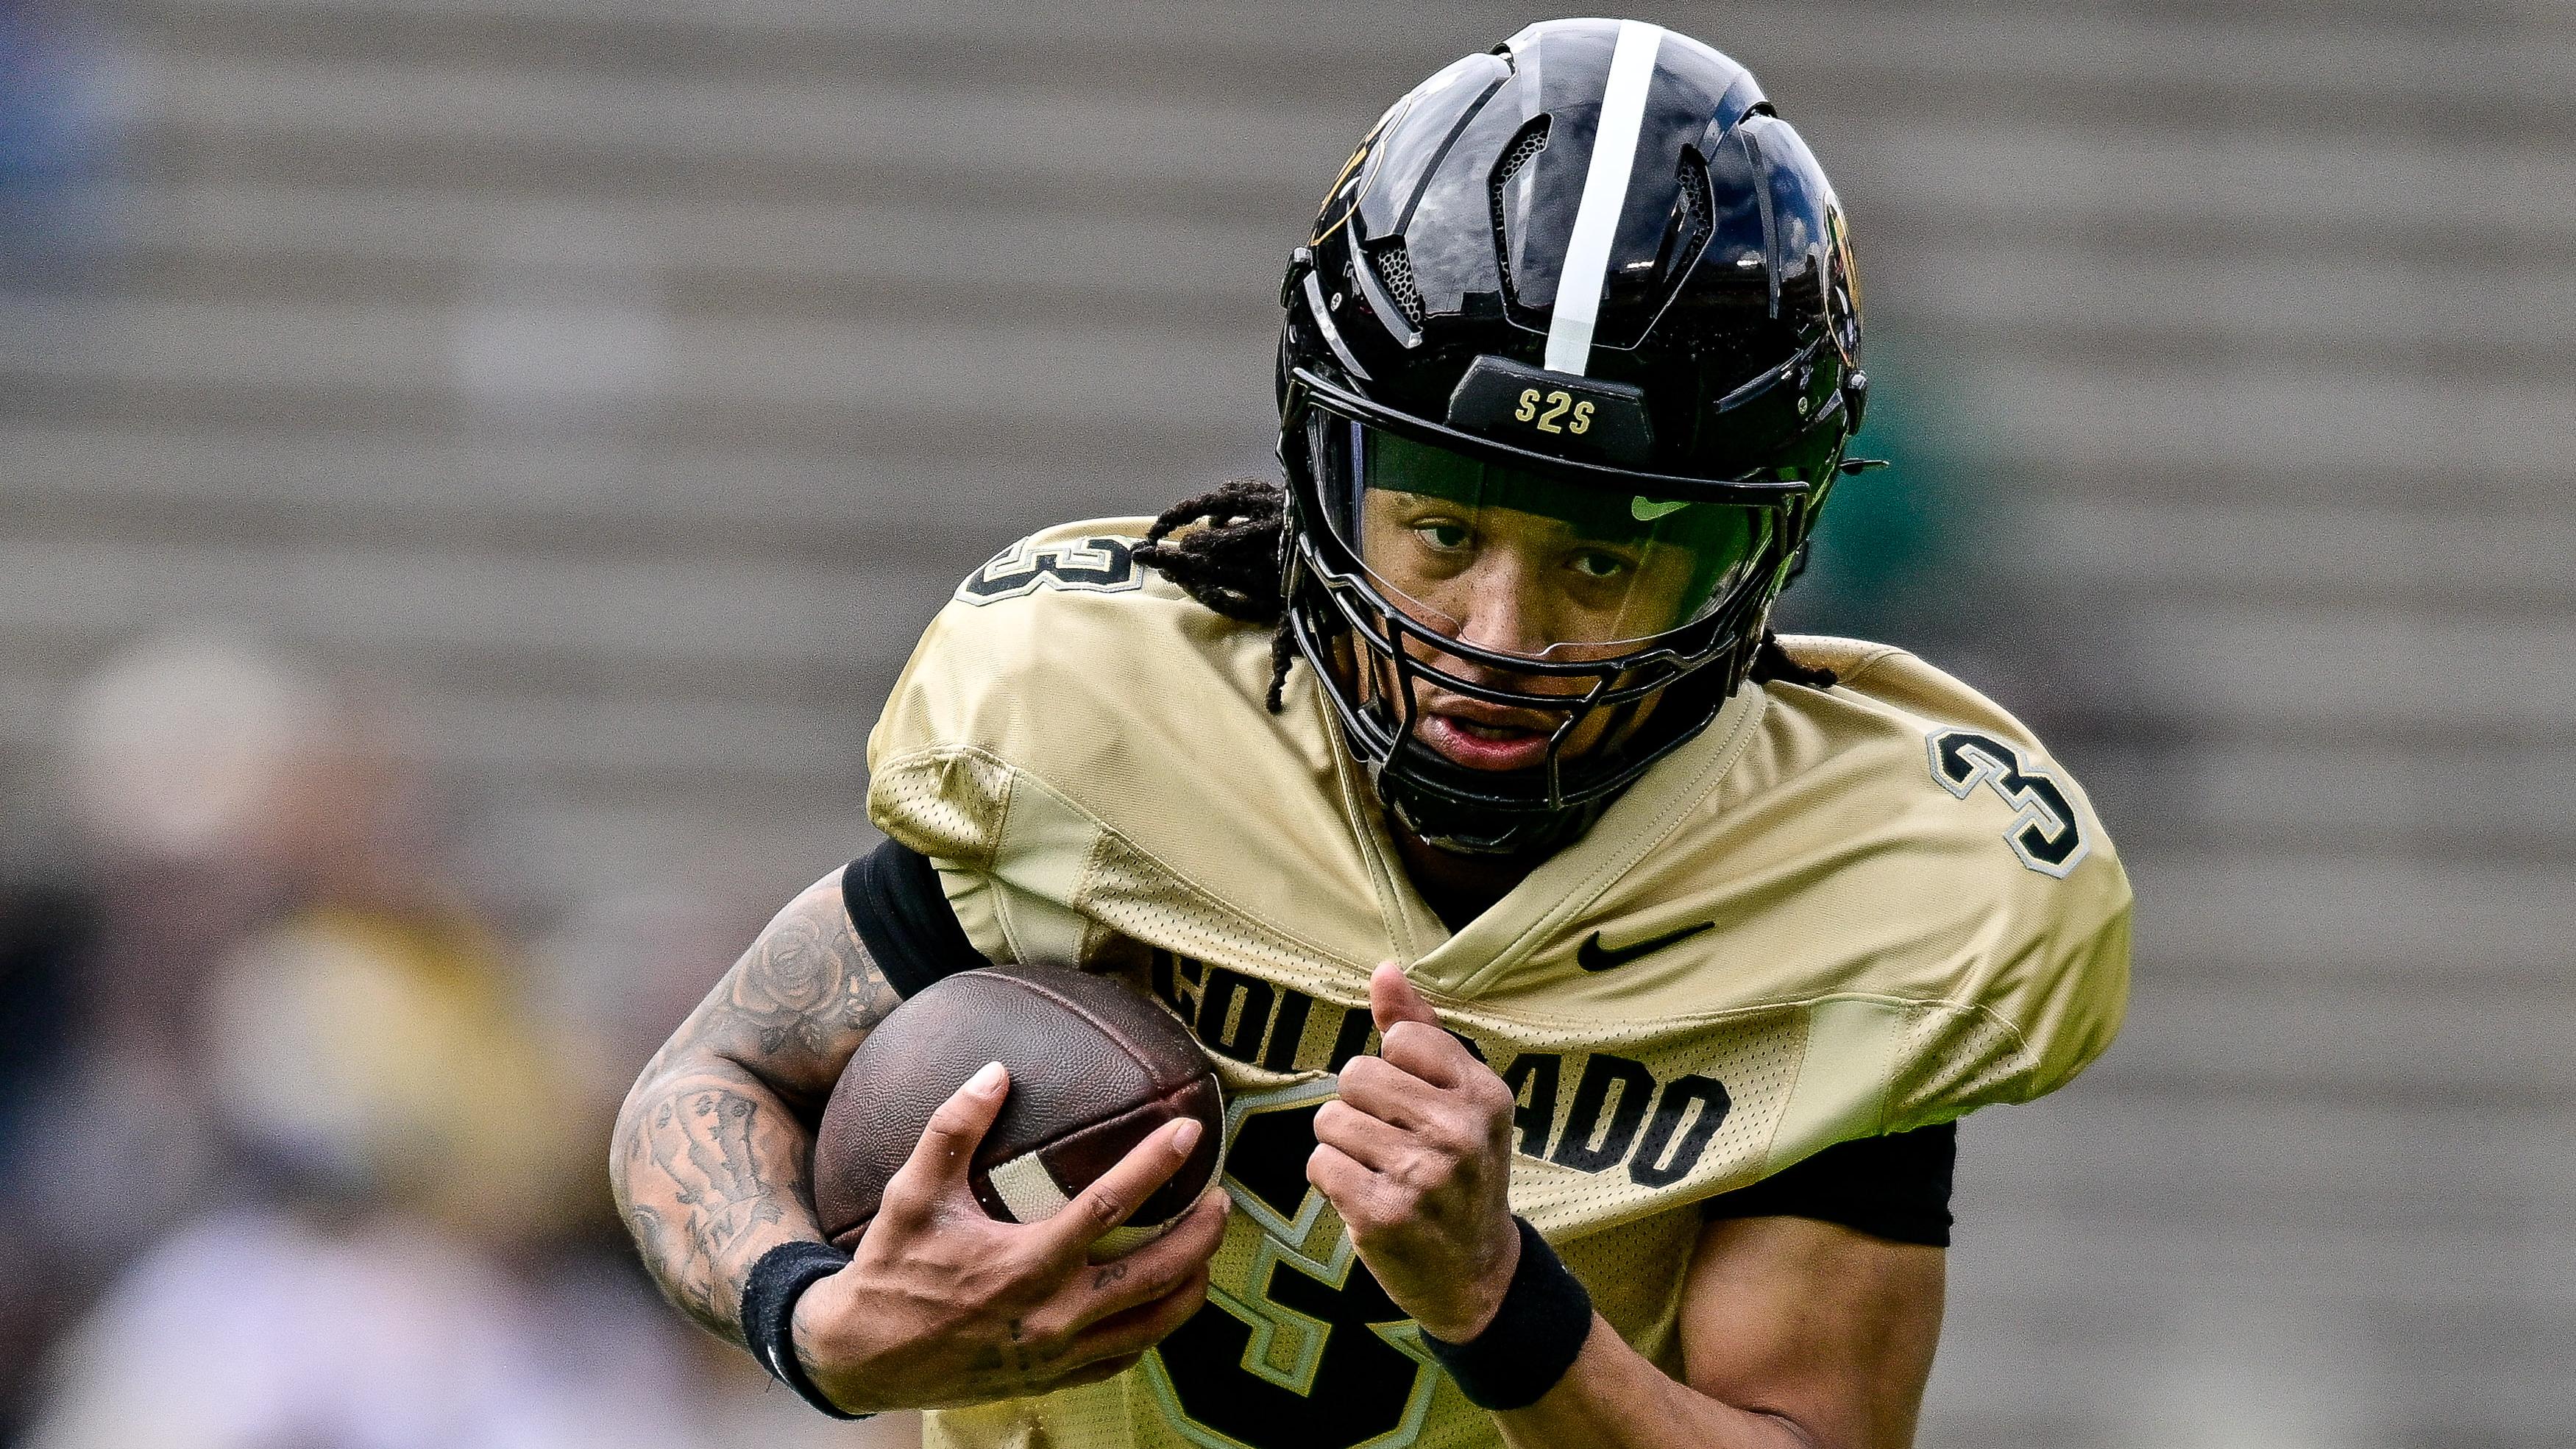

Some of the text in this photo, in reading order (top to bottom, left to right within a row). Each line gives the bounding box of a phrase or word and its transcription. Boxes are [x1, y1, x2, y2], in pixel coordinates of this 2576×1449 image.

[1515, 388, 1595, 434] S2S
[955, 534, 1143, 607] 3
[1925, 726, 2090, 879] 3
[1150, 946, 1732, 1188] COLADO
[1142, 1074, 1441, 1449] 3
